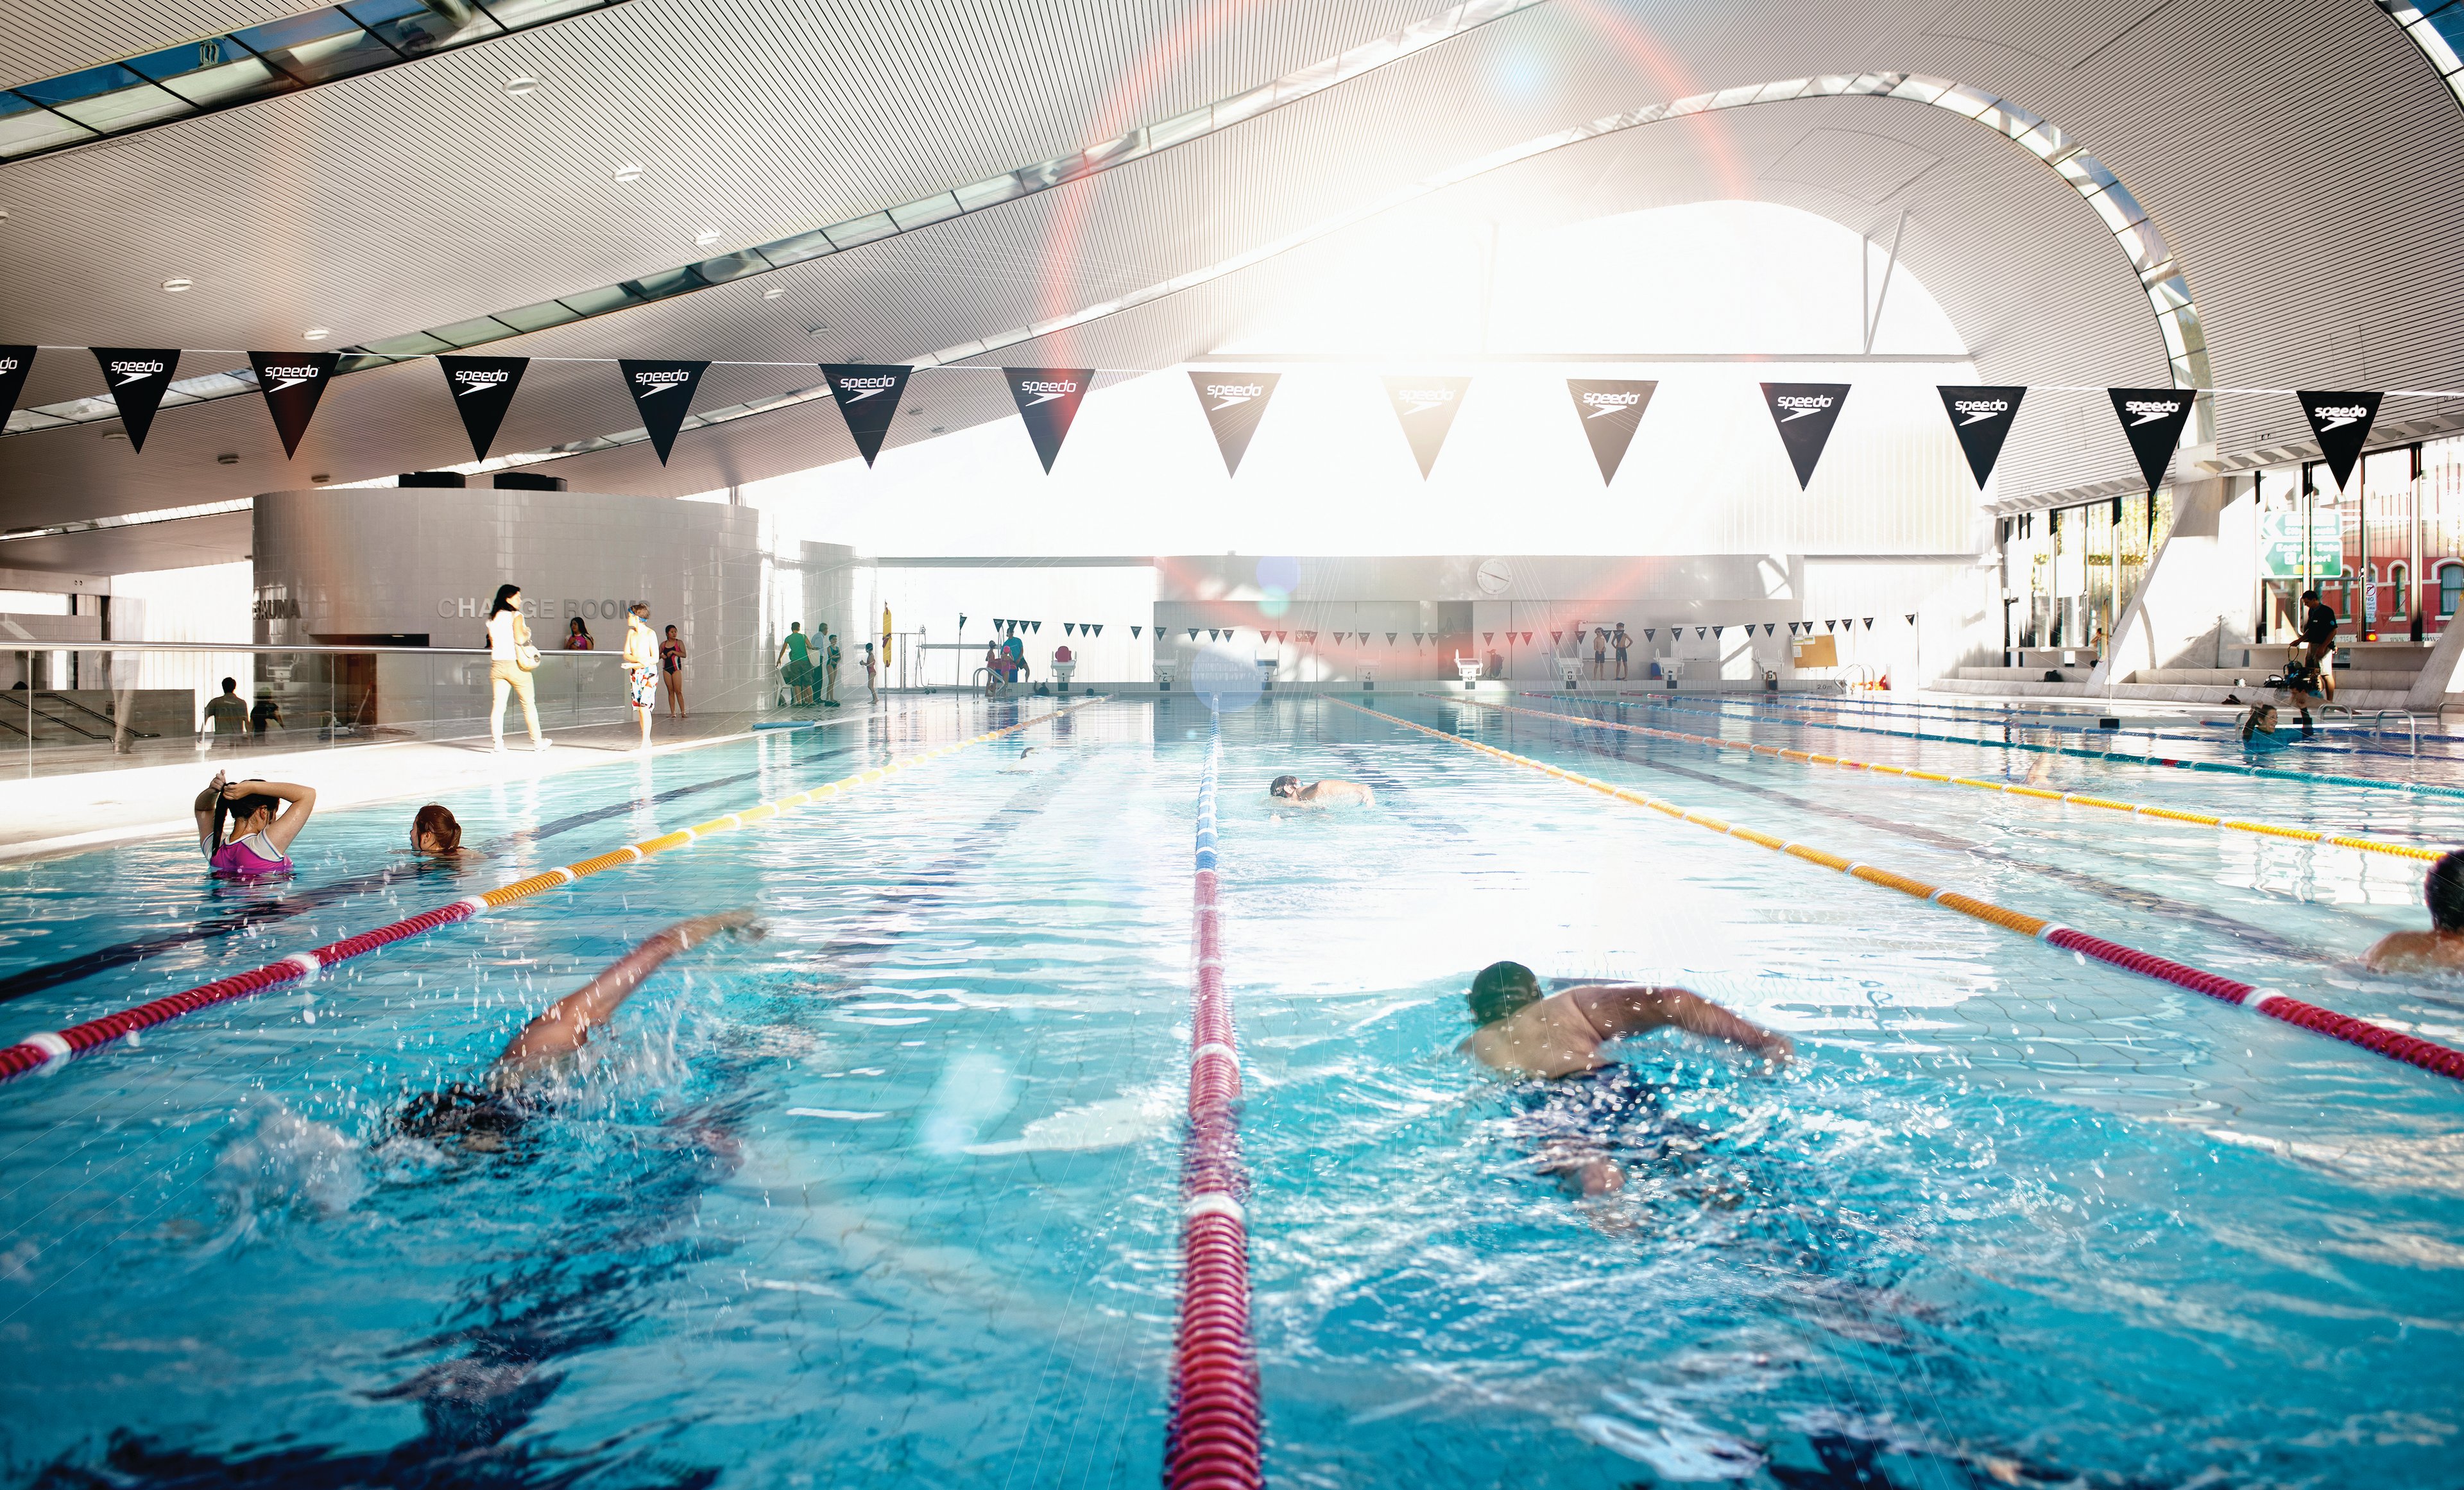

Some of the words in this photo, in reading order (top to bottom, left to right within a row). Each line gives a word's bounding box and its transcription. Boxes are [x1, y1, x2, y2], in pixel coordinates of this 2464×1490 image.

[111, 359, 164, 375] speedo
[265, 364, 318, 379] speedo
[456, 368, 508, 384] speedo
[635, 370, 689, 385] speedo
[840, 375, 894, 391] speedo
[1022, 380, 1076, 395] speedo
[1207, 383, 1262, 398] speedo
[1399, 388, 1453, 402] speedo
[1583, 391, 1637, 406] speedo
[1777, 395, 1831, 409] speedo
[1955, 398, 2008, 413] speedo
[2126, 400, 2180, 414] speedo
[2314, 404, 2368, 419] speedo
[437, 597, 554, 619] CHAGE
[1264, 672, 1270, 681] 3
[1365, 672, 1371, 681] 4
